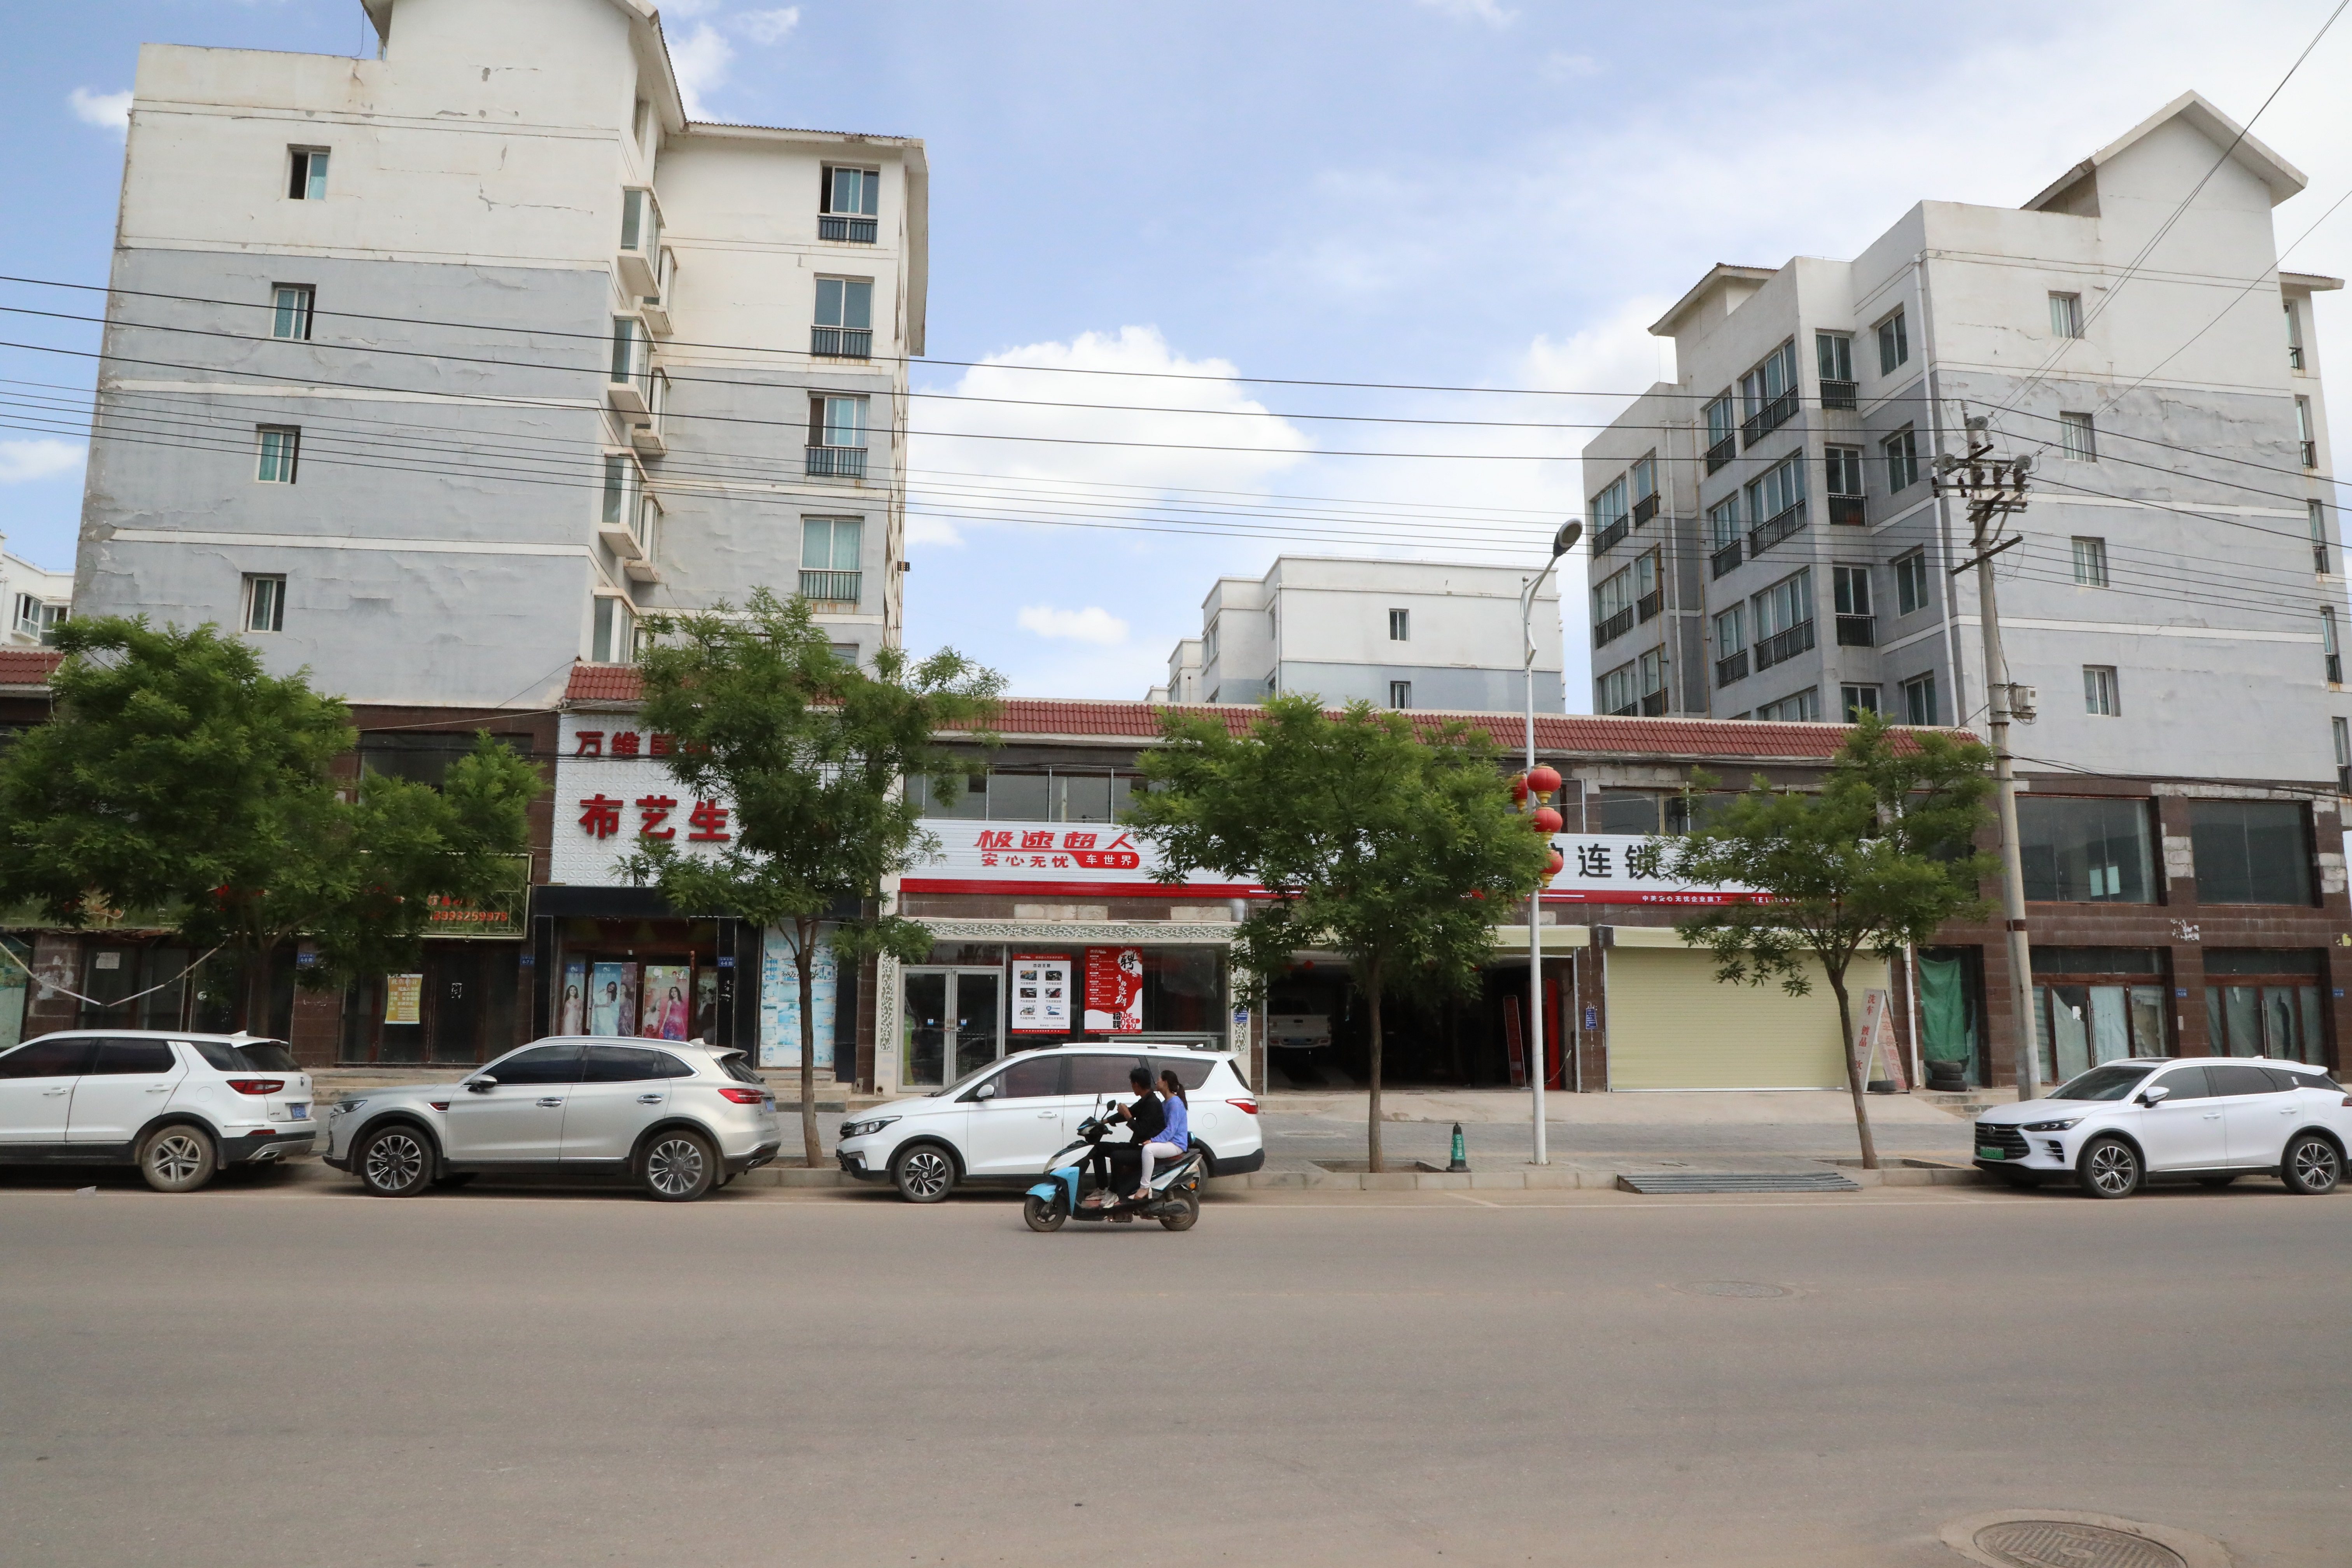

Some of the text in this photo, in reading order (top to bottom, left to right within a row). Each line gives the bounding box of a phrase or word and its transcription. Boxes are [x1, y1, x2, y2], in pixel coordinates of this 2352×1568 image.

[576, 731, 712, 756] 万维国
[578, 793, 731, 842] 布艺生
[973, 830, 1135, 849] 极速超人
[982, 852, 1069, 868] 安心无忧
[1086, 854, 1132, 866] 车世界
[1549, 843, 1659, 880] 连锁
[1121, 954, 1138, 970] 聘
[1867, 994, 1876, 1015] 洗车
